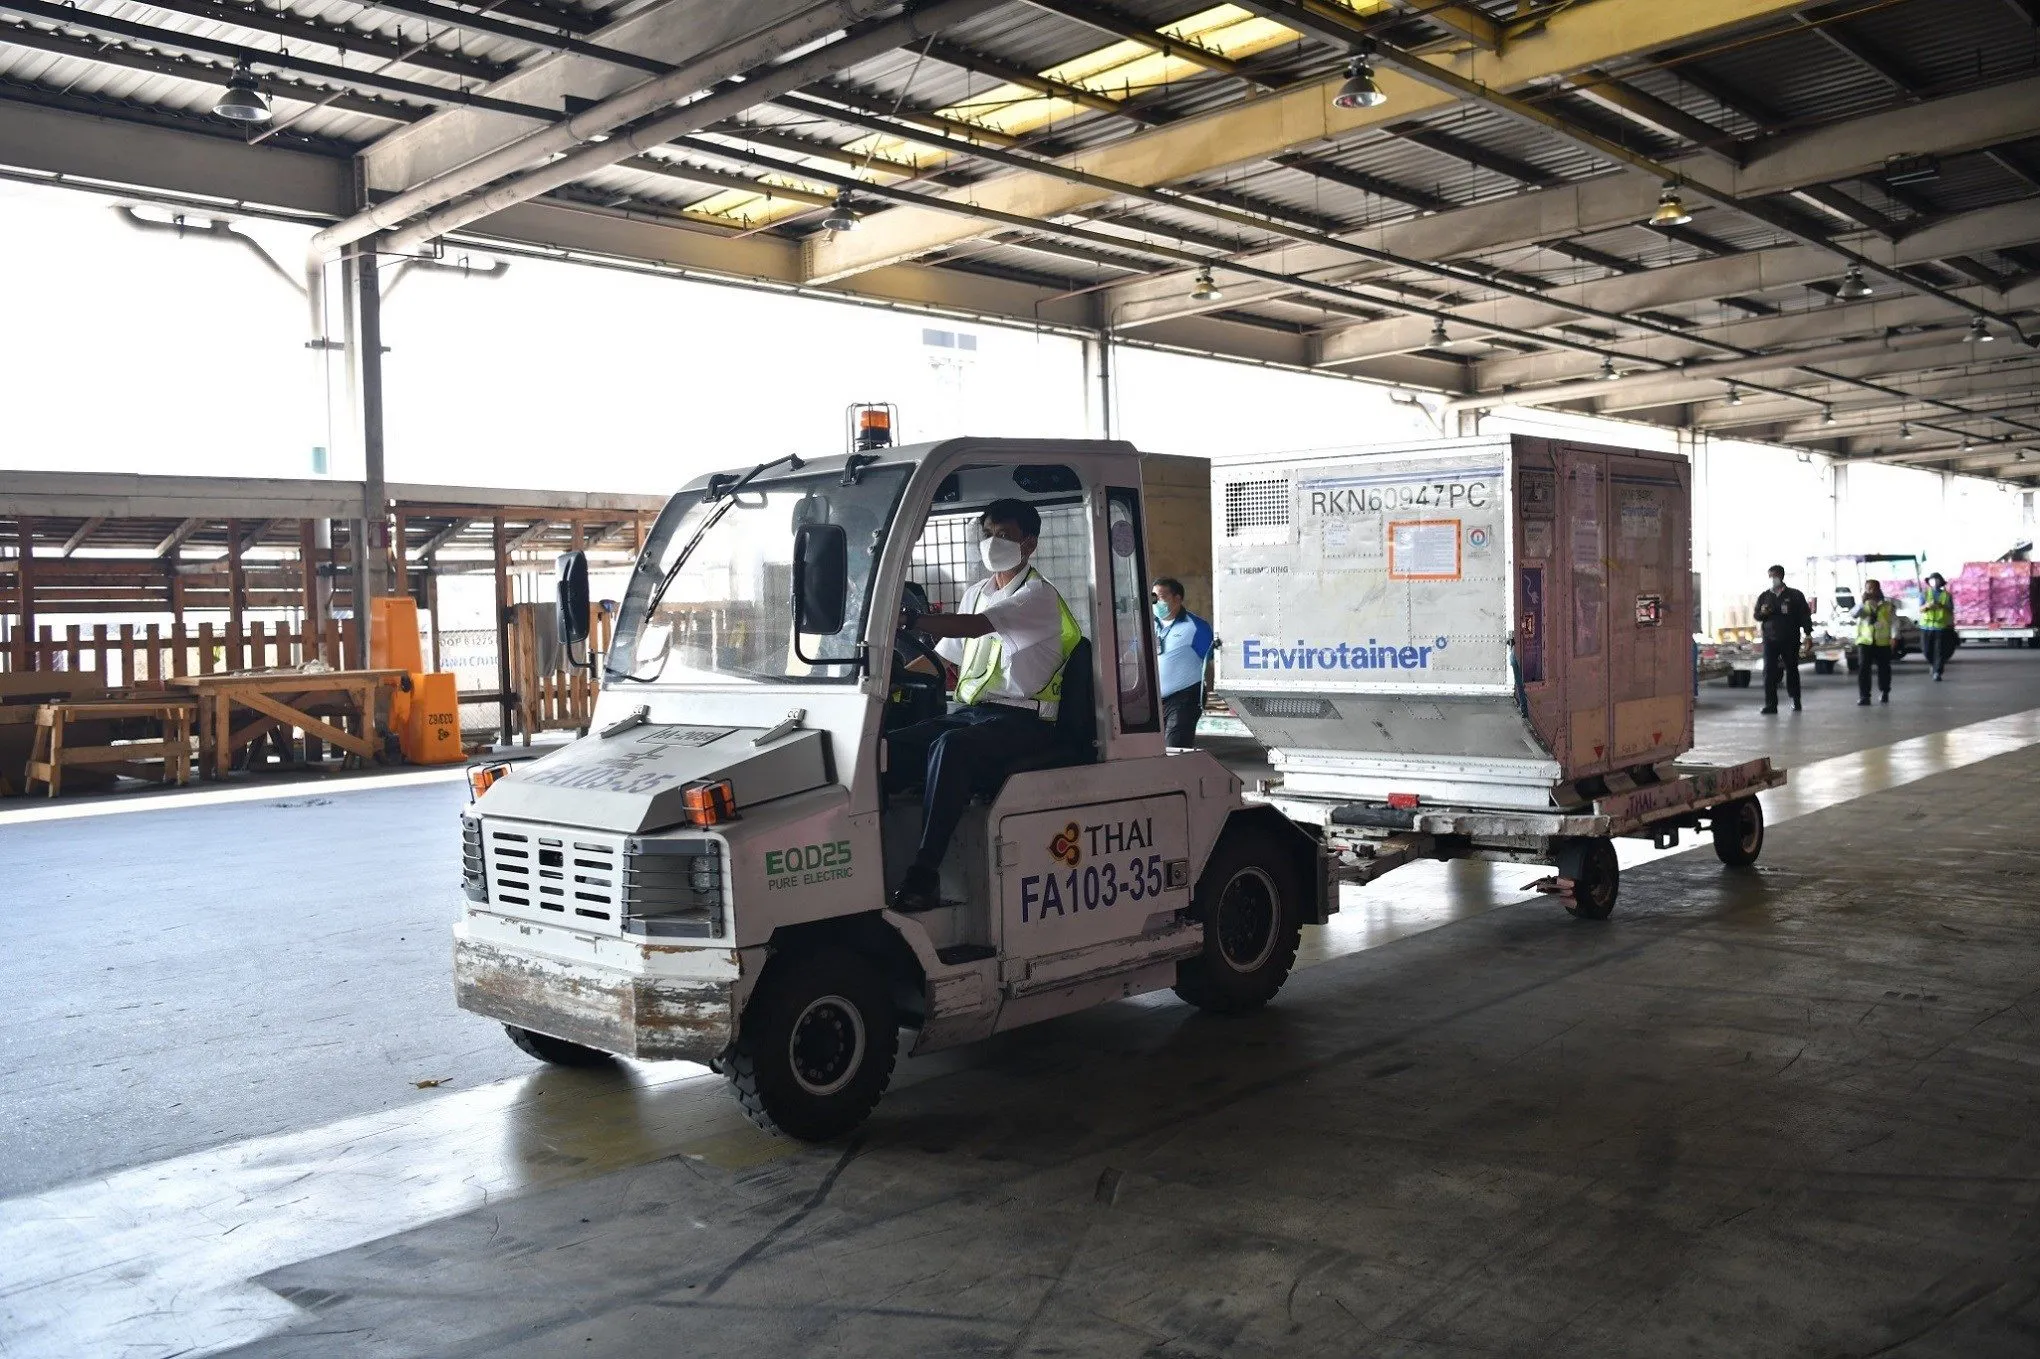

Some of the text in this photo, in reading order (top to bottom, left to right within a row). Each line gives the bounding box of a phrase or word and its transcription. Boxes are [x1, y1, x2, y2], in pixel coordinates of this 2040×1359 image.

[1311, 482, 1486, 515] RKN60947PC
[1270, 566, 1289, 574] KING
[1243, 639, 1432, 670] Envirotainer
[1084, 817, 1154, 856] THAI
[765, 840, 852, 875] EQD25
[768, 867, 853, 891] PURE ELECTRIC
[1021, 854, 1162, 922] FA103-35
